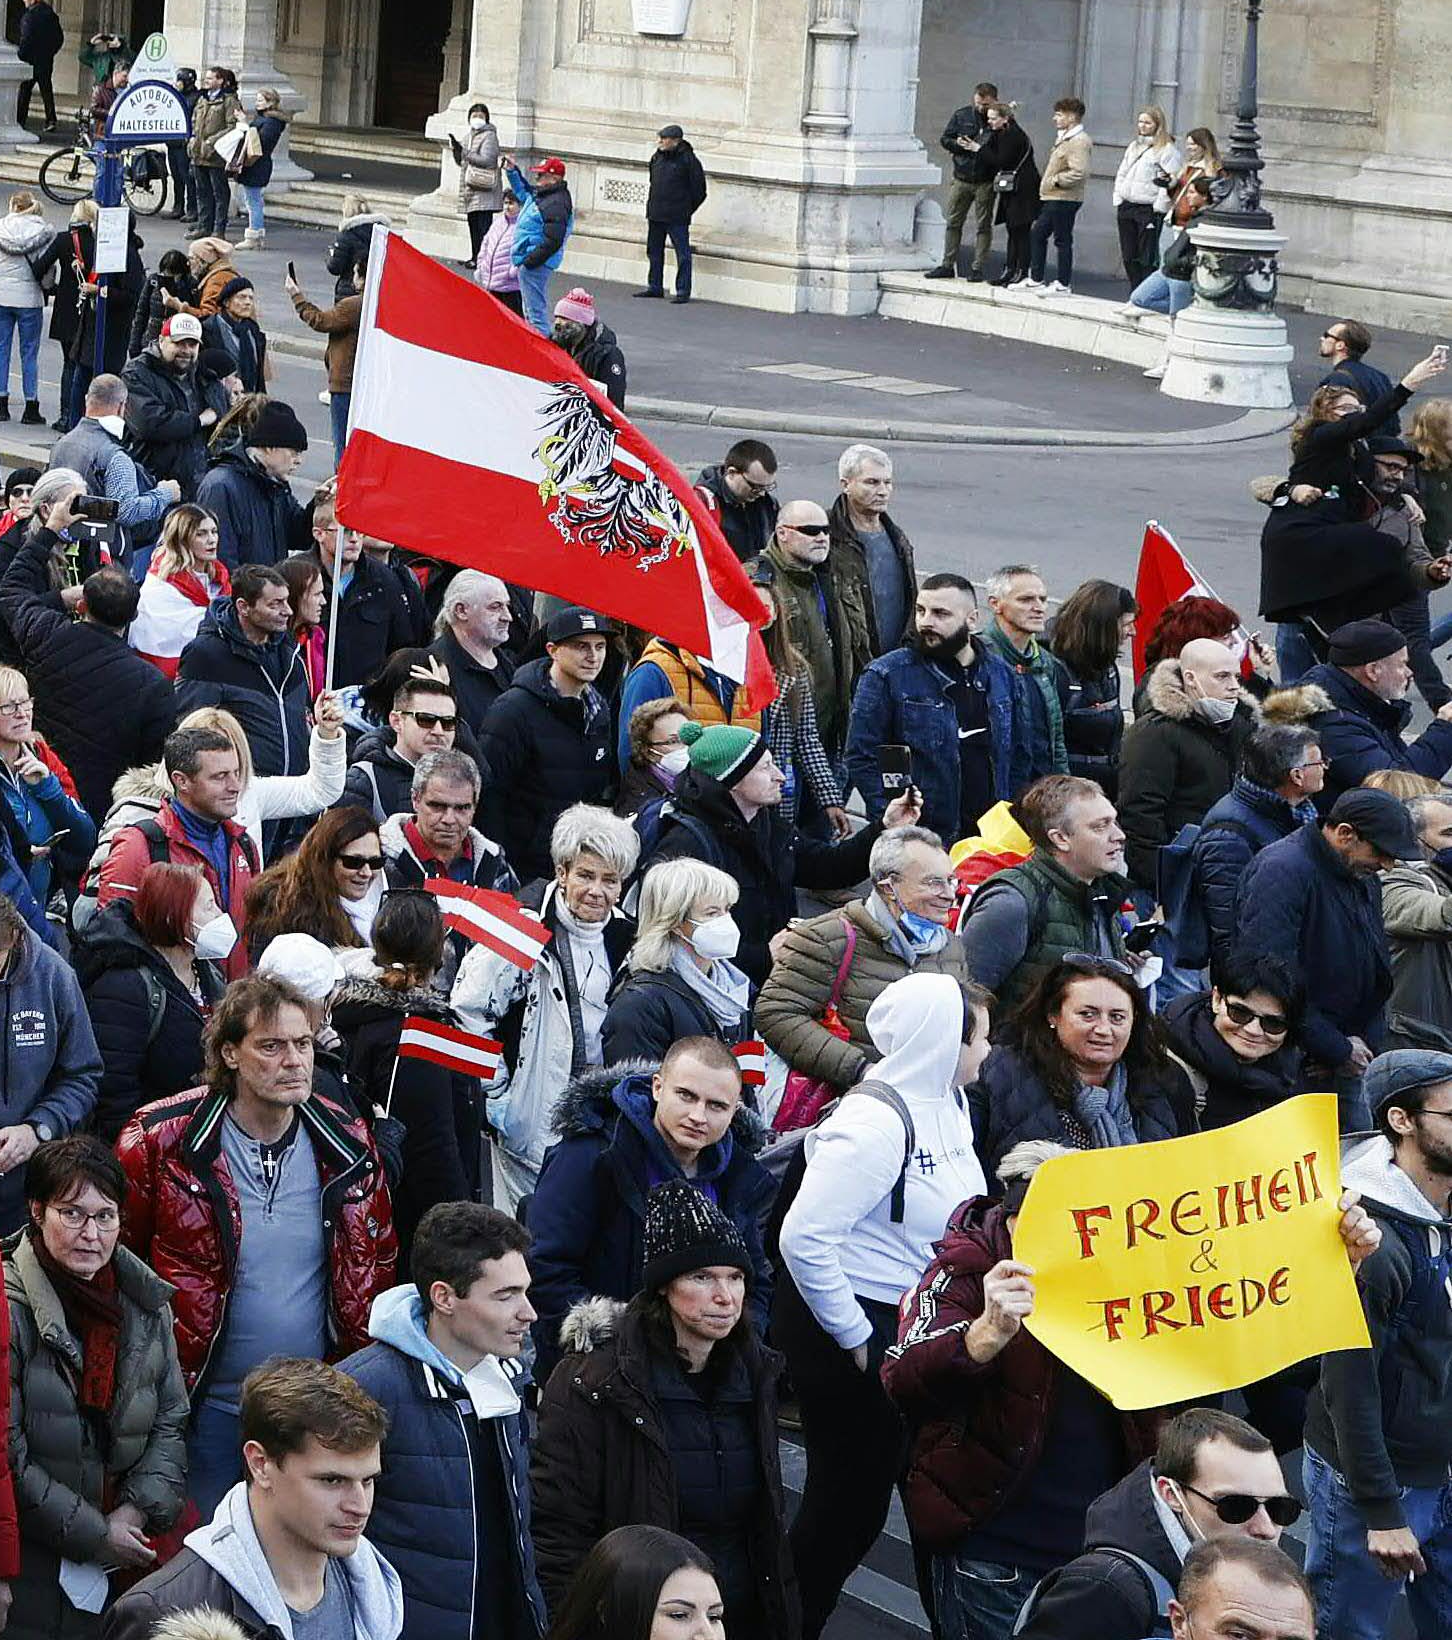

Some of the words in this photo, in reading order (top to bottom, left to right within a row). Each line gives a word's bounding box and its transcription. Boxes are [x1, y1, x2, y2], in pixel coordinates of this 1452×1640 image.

[129, 88, 174, 109] AUTOBUS
[119, 119, 181, 132] HALTESTELLE
[12, 1012, 22, 1022] FC
[20, 1010, 45, 1021] BAYERN
[15, 1032, 45, 1041] MÜNCHEN
[1068, 1151, 1323, 1260] FREIHEIT
[1189, 1238, 1219, 1274] &
[1088, 1266, 1292, 1342] FRIEDE
